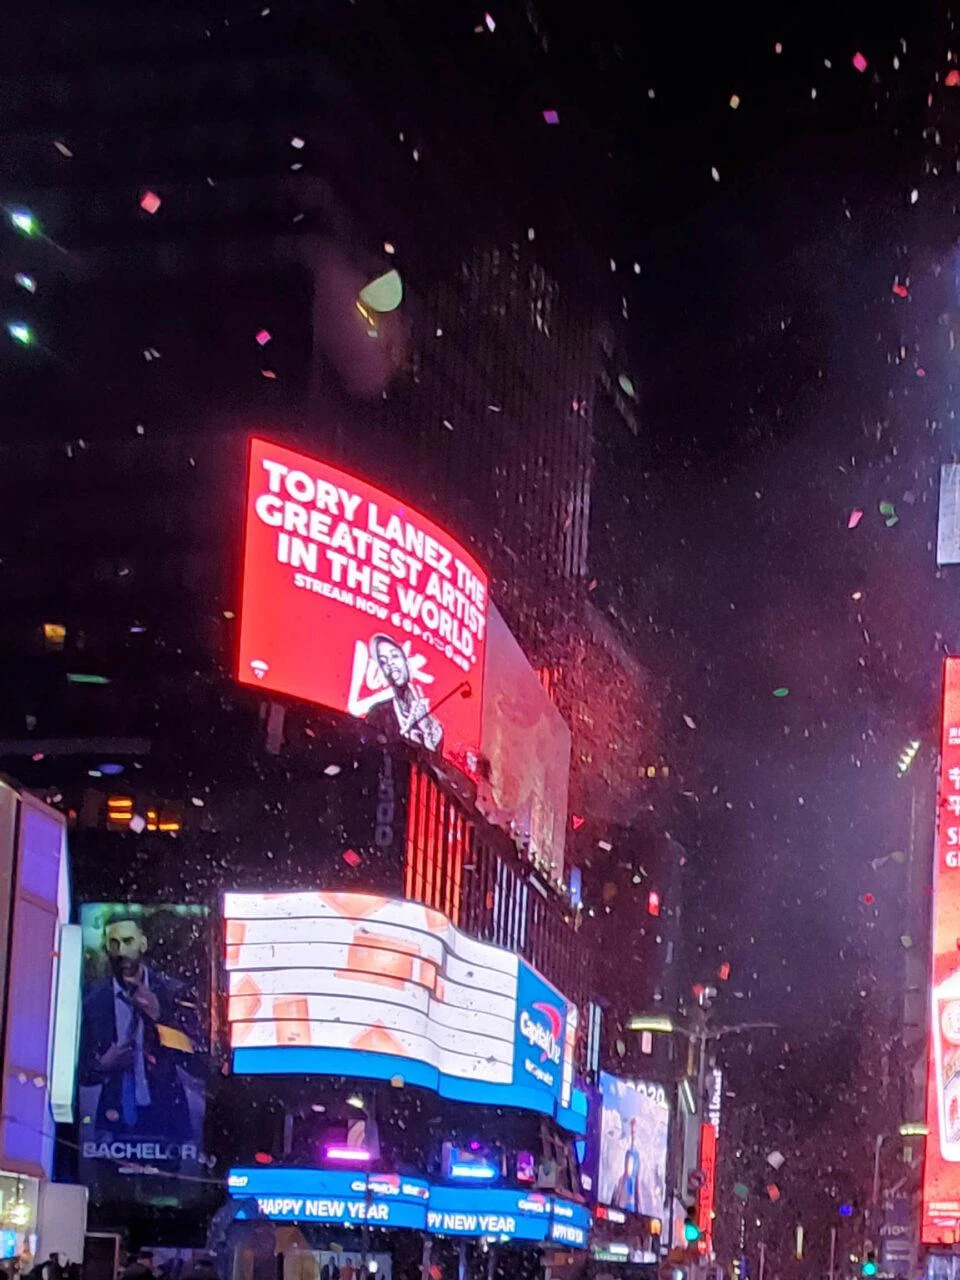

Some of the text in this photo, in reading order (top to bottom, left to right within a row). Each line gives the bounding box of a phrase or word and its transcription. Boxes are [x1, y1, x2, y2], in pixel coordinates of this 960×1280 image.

[256, 494, 486, 641] GREATEST ARTIST
[262, 459, 486, 612] TORY LANEZ THE
[277, 532, 478, 664] IN THE WORLD.
[294, 573, 389, 620] STREAM NOW
[257, 1198, 389, 1220] HAPPY NEW YEAR
[443, 1213, 478, 1230] NEW
[478, 1213, 516, 1232] YEAR
